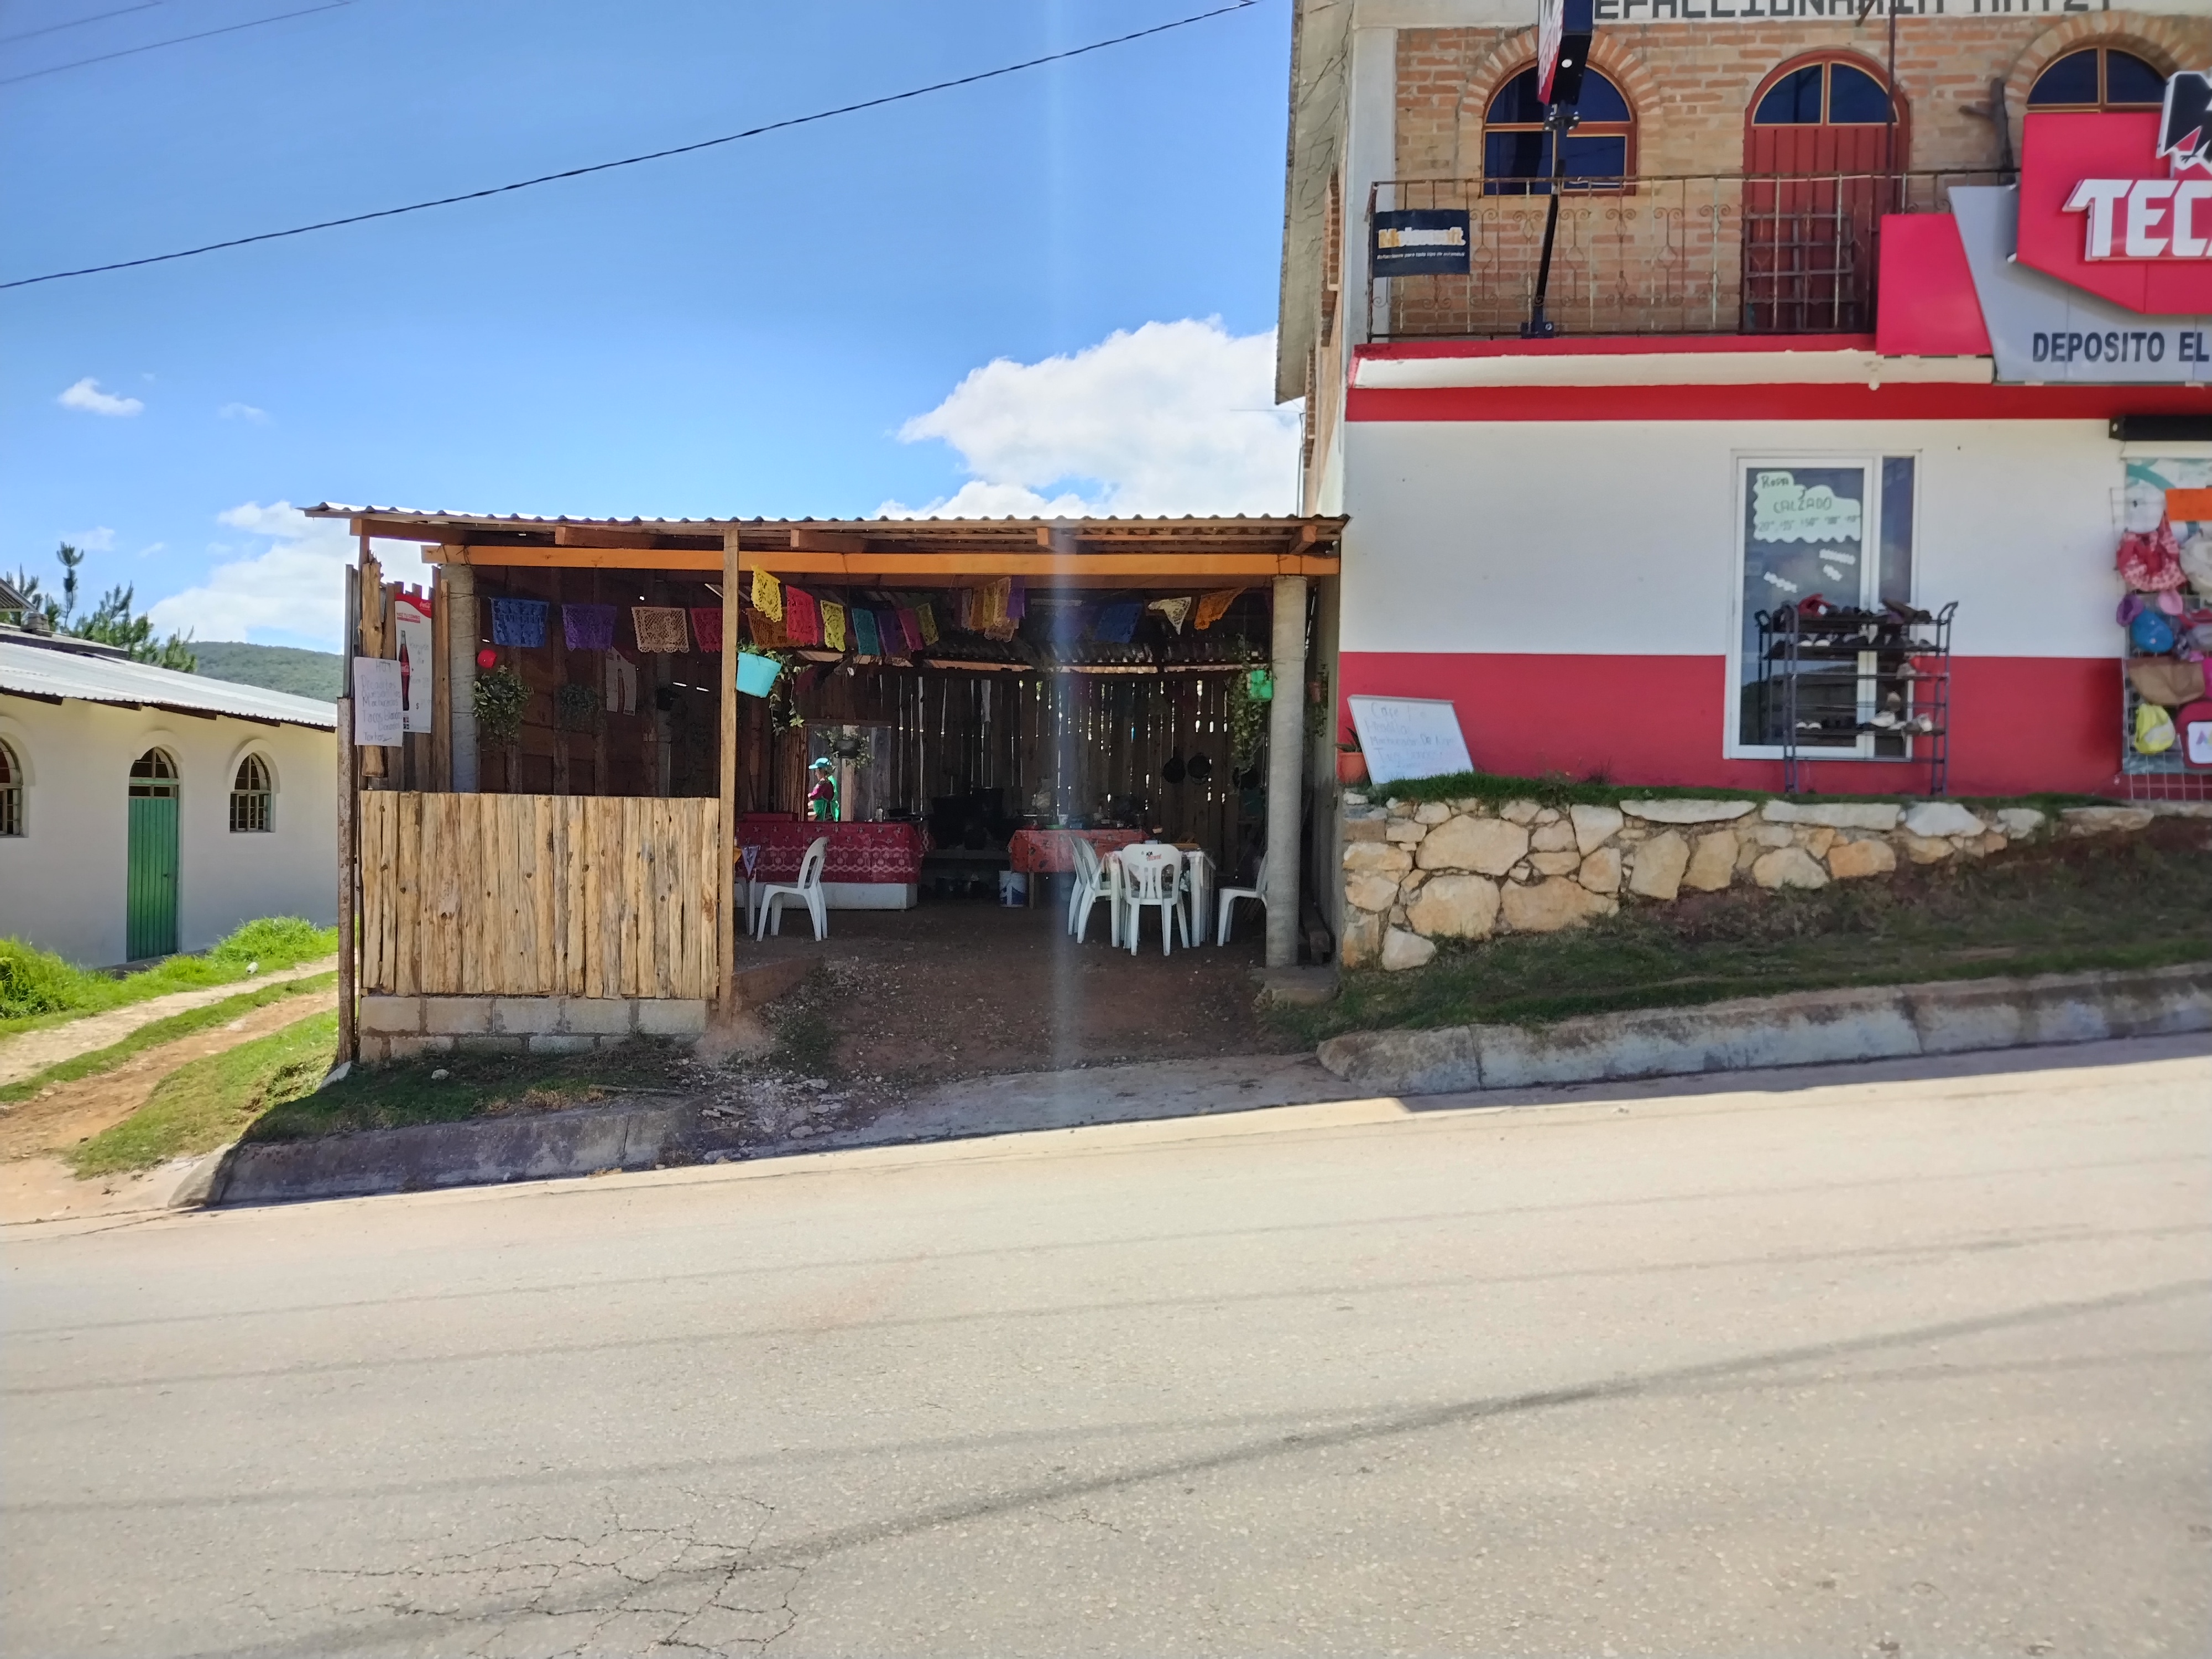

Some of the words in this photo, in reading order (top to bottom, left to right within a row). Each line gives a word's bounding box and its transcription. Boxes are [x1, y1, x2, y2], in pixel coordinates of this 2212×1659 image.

[2063, 179, 2212, 259] TEC
[2033, 332, 2165, 362] DEPOSITO
[1773, 496, 1832, 514] CALZADO
